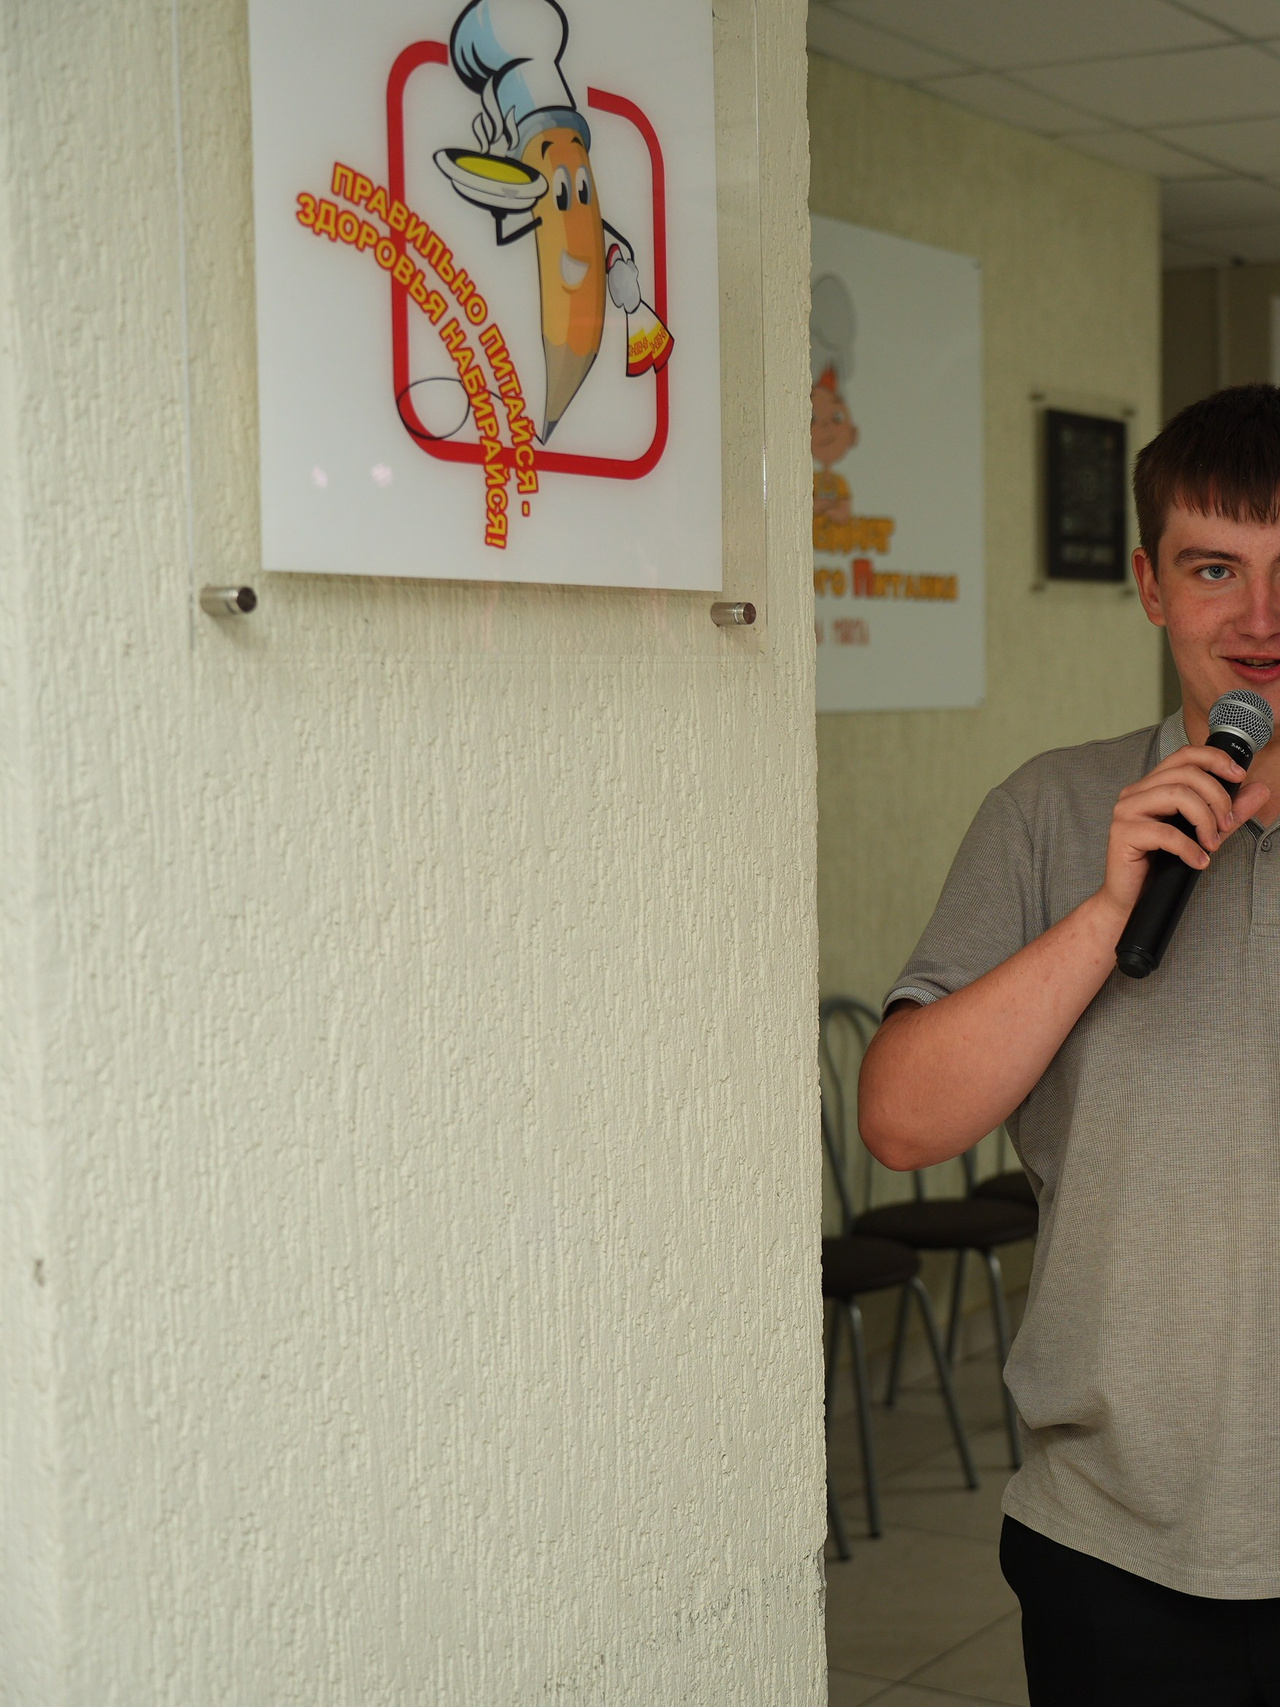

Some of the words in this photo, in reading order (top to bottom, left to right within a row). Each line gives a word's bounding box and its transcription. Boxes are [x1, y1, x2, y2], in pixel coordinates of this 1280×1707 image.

[296, 193, 448, 326] ЗДОРОВЬЯ
[439, 319, 510, 550] НАБИРАЙСЯ!
[331, 162, 488, 326] ПРАВИЛЬНО
[478, 323, 540, 494] ПИТАЙСЯ
